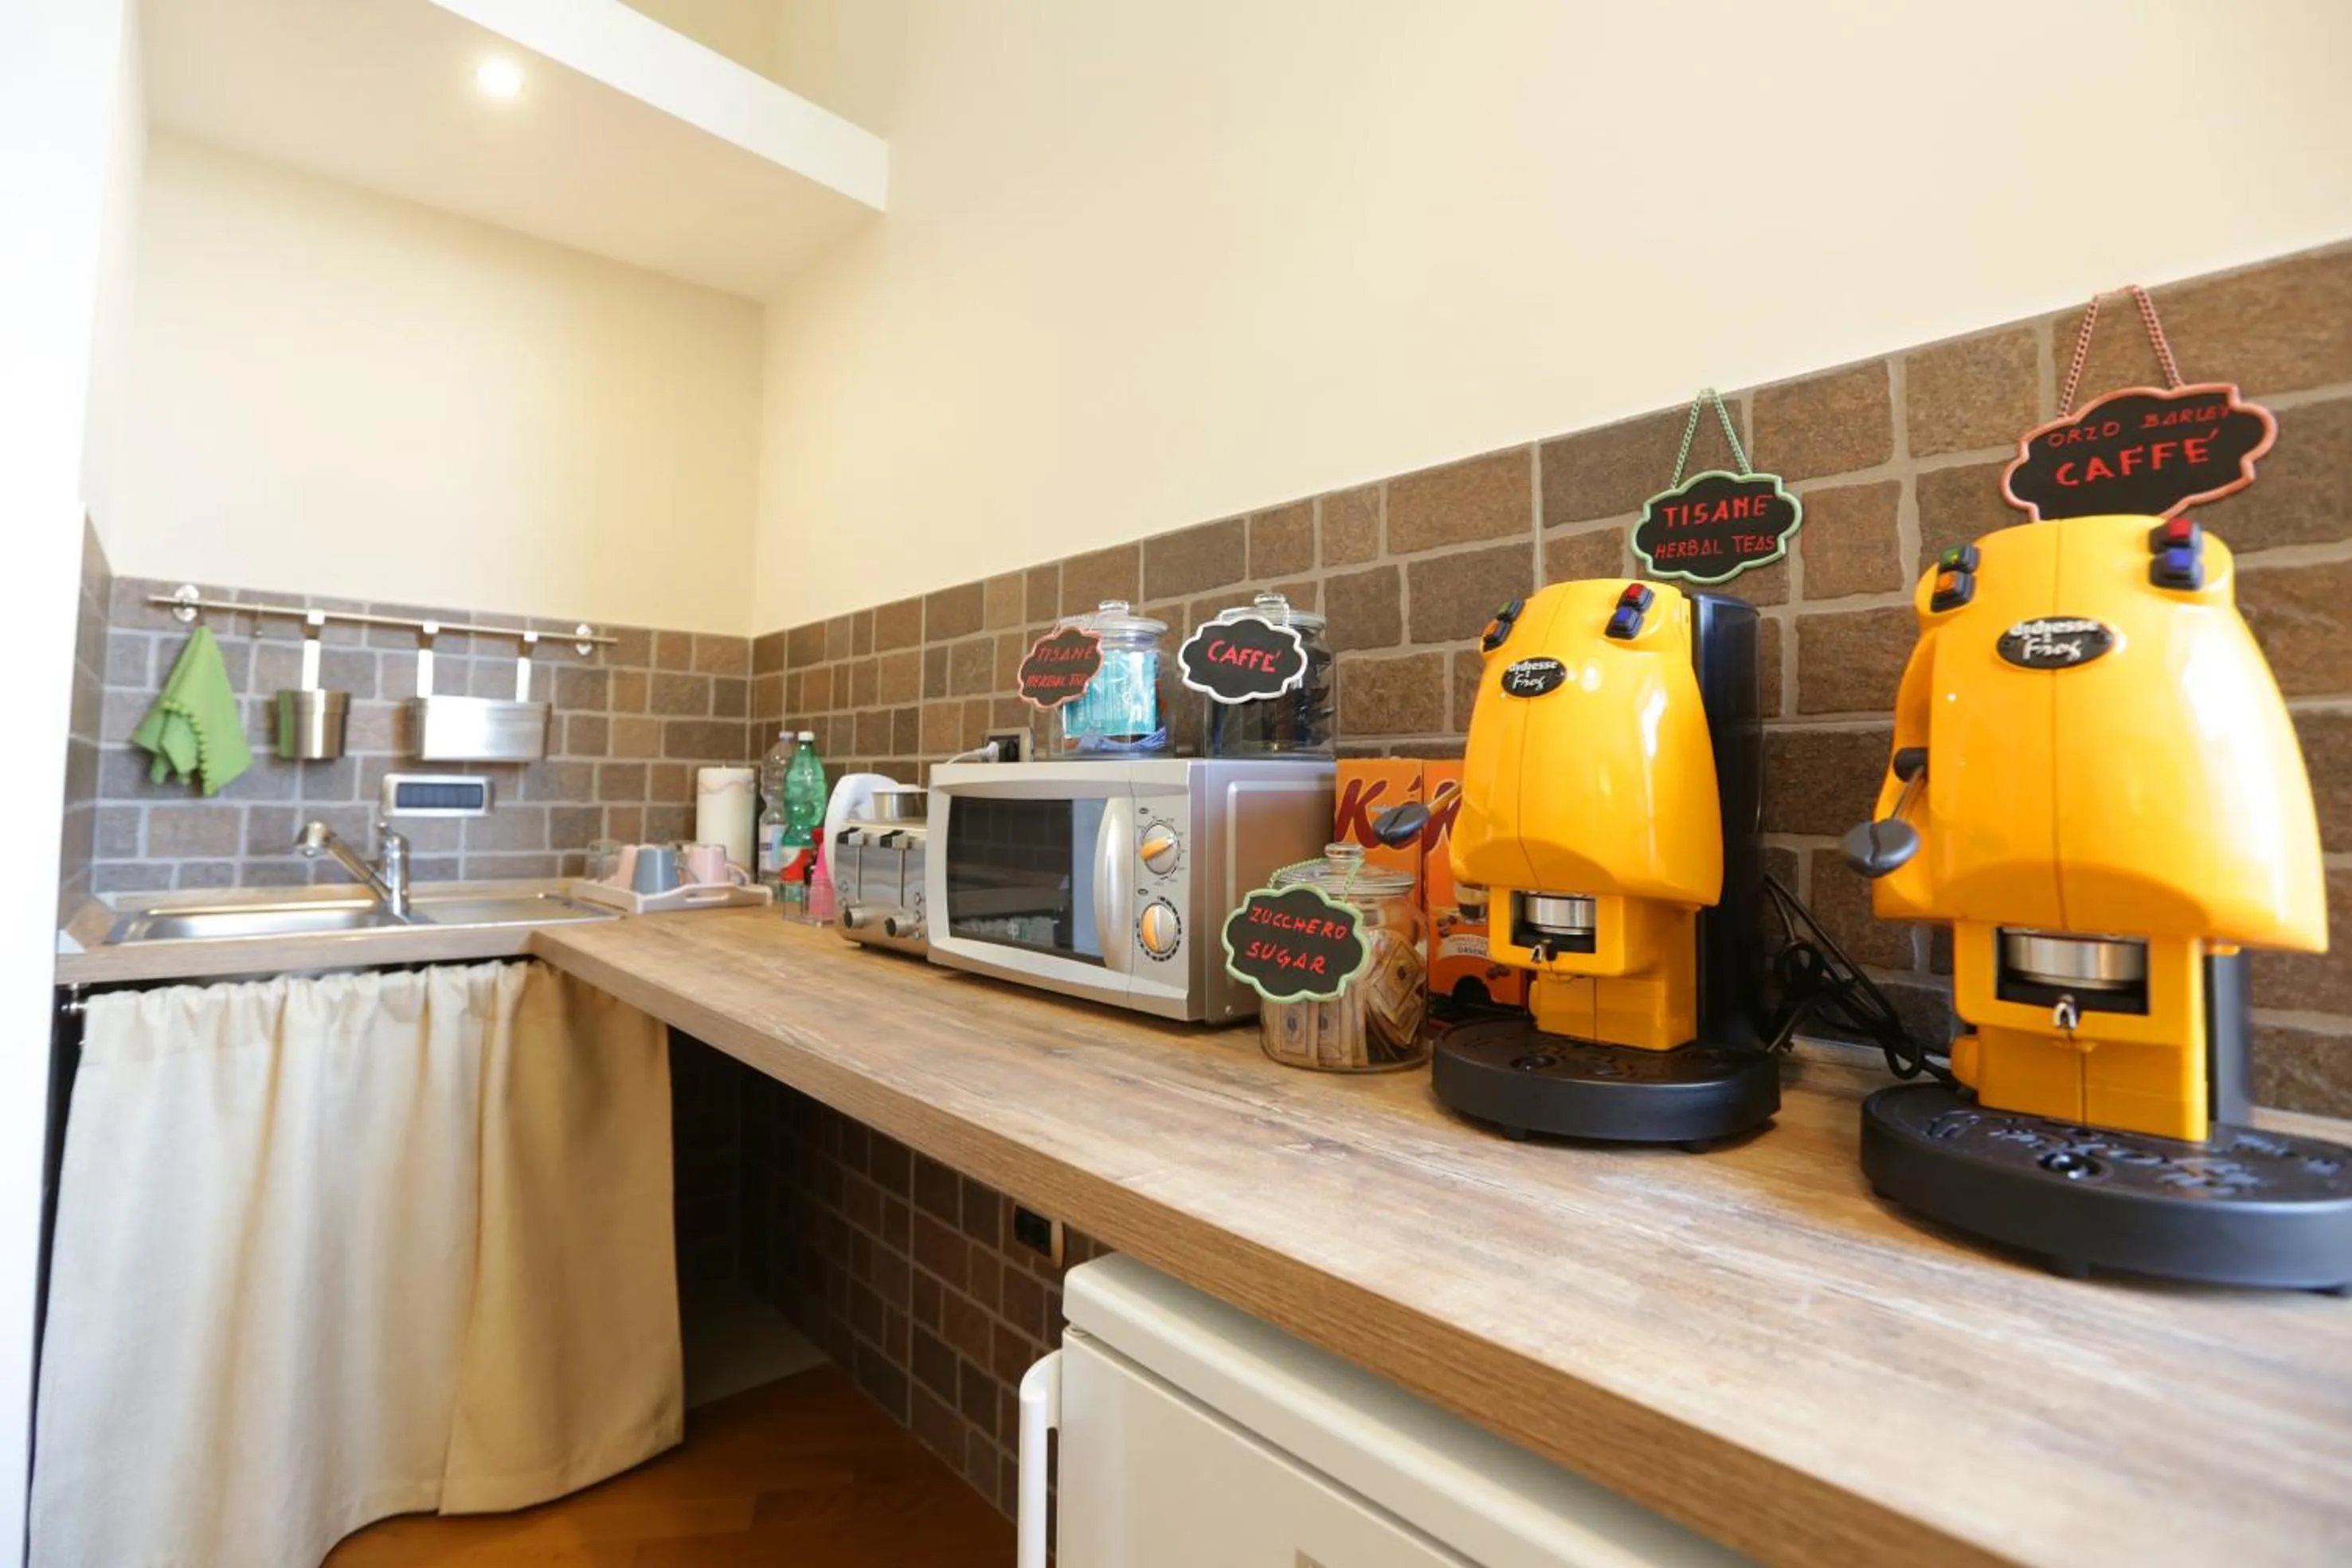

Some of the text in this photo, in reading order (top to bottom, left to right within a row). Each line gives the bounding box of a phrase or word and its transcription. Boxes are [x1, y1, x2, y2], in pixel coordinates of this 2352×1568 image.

[2048, 404, 2232, 448] ORZO BARLEY
[1662, 494, 1774, 529] TISANE
[1653, 534, 1775, 559] HERBAL TEAS
[1248, 906, 1347, 940] ZUCCHERO
[1246, 941, 1326, 976] SUGAR
